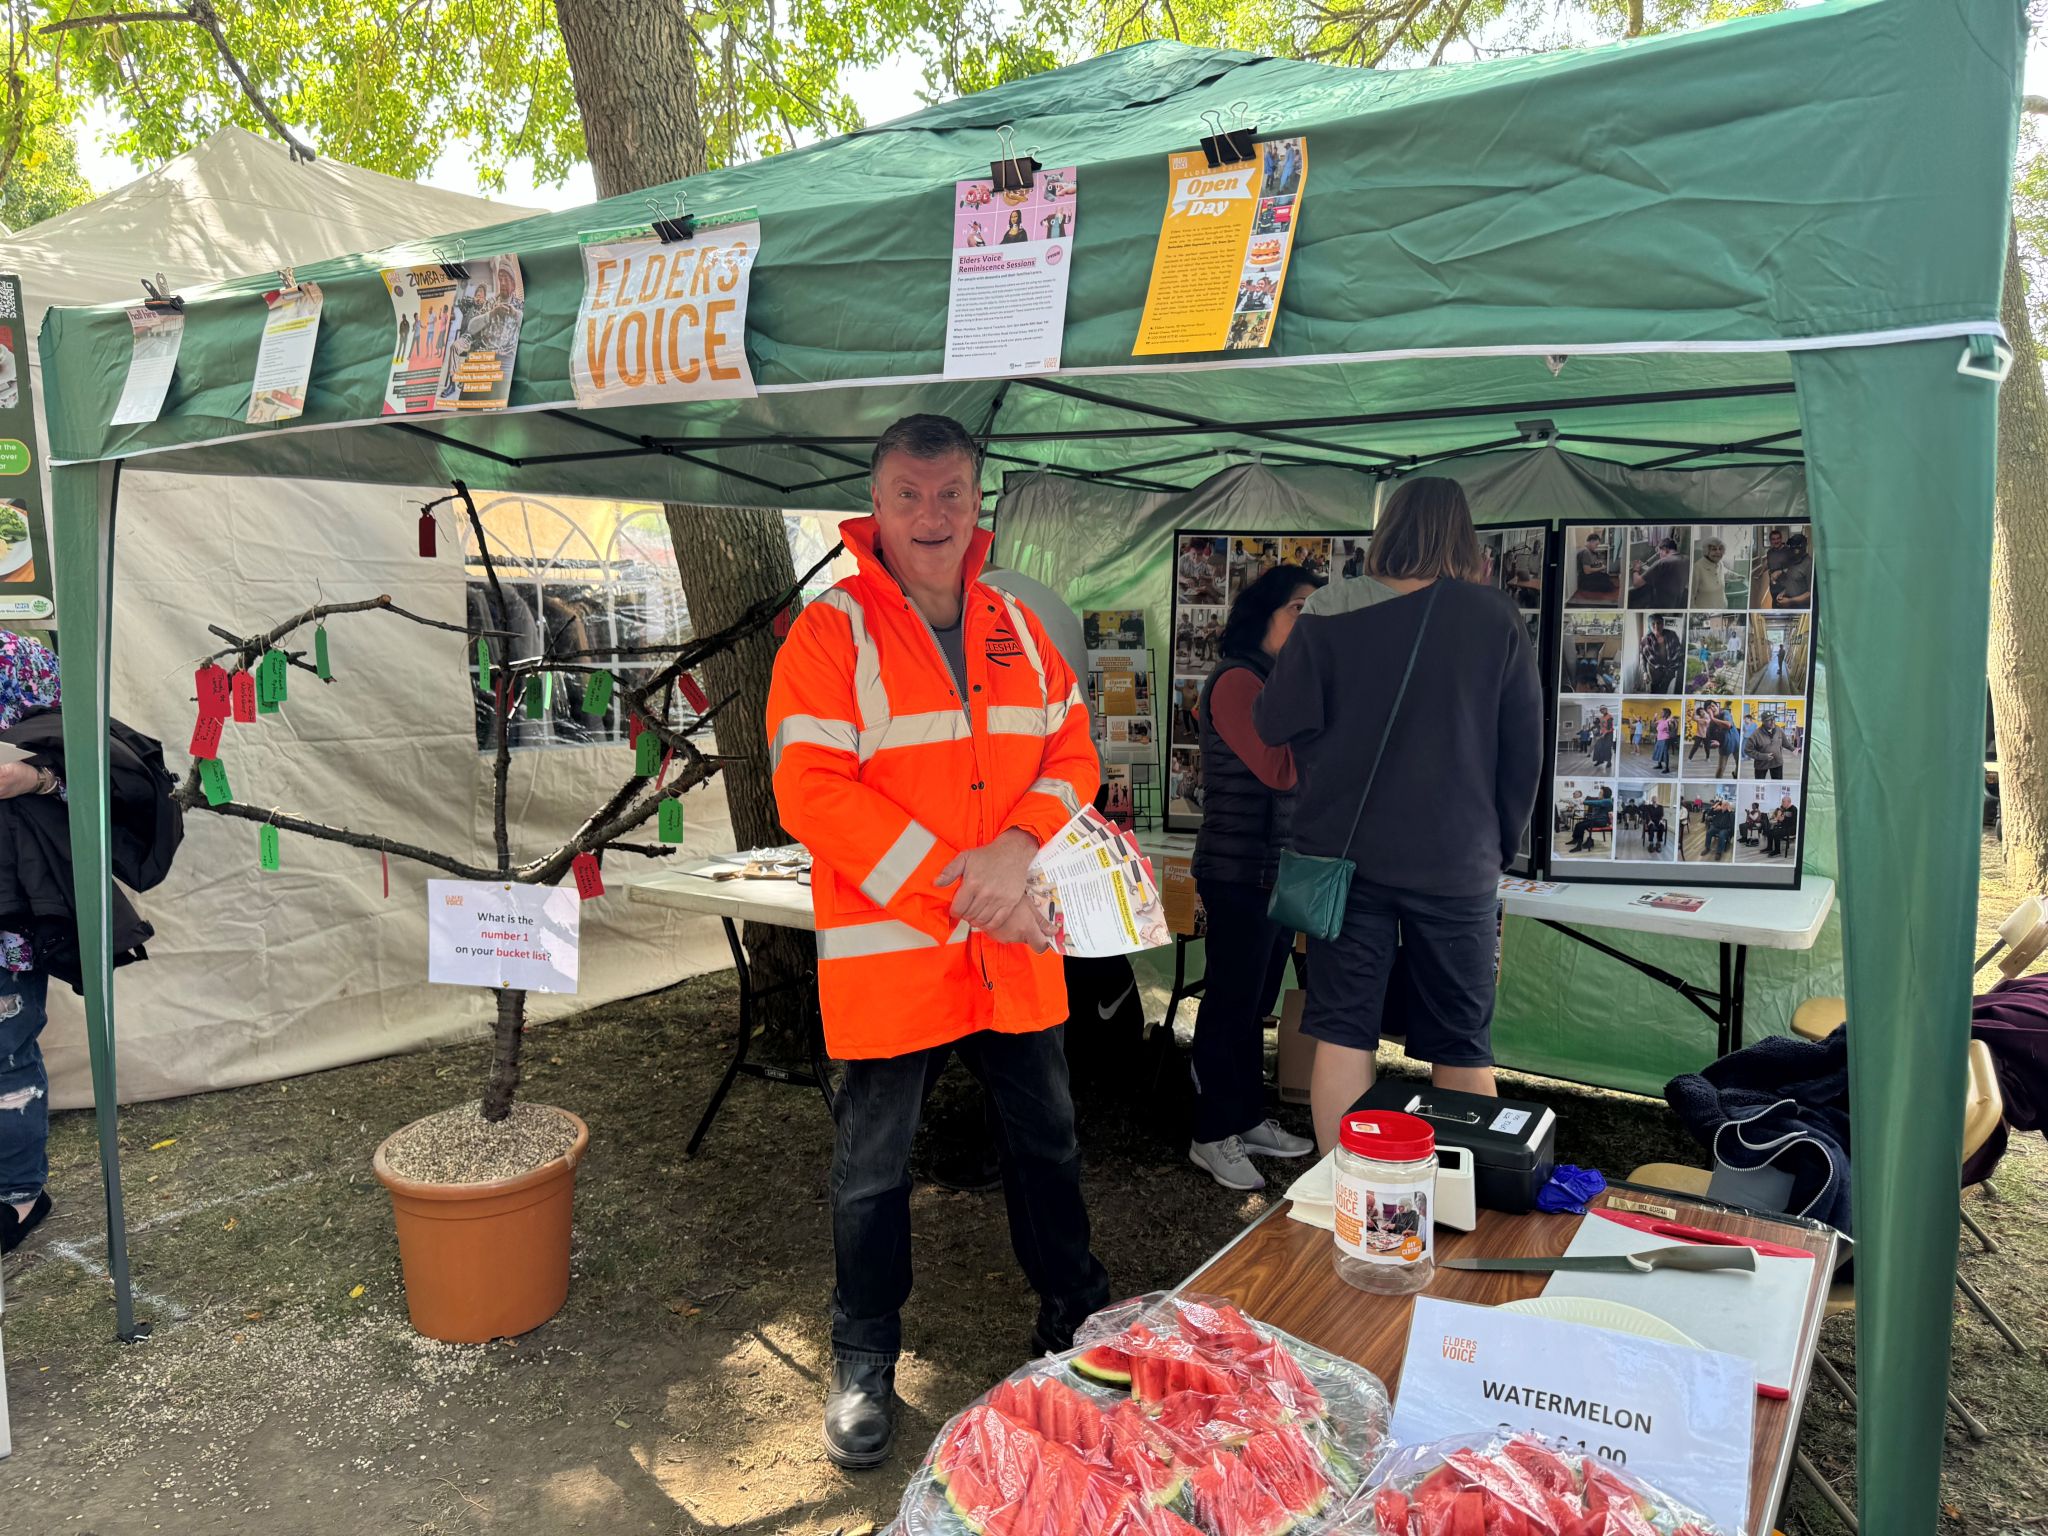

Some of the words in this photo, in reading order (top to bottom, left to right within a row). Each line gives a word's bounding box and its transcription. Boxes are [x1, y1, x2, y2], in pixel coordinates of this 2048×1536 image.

[1186, 177, 1240, 197] Open
[1186, 200, 1230, 217] Day
[959, 264, 1005, 273] Reminiscence
[1006, 260, 1035, 269] Sessions
[960, 256, 980, 264] Elders
[406, 270, 439, 287] ZUMBA
[591, 242, 748, 311] ELDERS
[587, 298, 741, 389] VOICE
[477, 912, 505, 922] What
[508, 914, 515, 923] is
[518, 916, 534, 925] the
[481, 930, 521, 940] number
[524, 933, 528, 941] 1
[471, 947, 493, 956] your
[496, 948, 530, 959] bucket
[532, 951, 552, 962] list?
[1443, 1336, 1478, 1350] ELDERS
[1442, 1346, 1476, 1363] VOICE
[1482, 1380, 1652, 1435] WATERMELON
